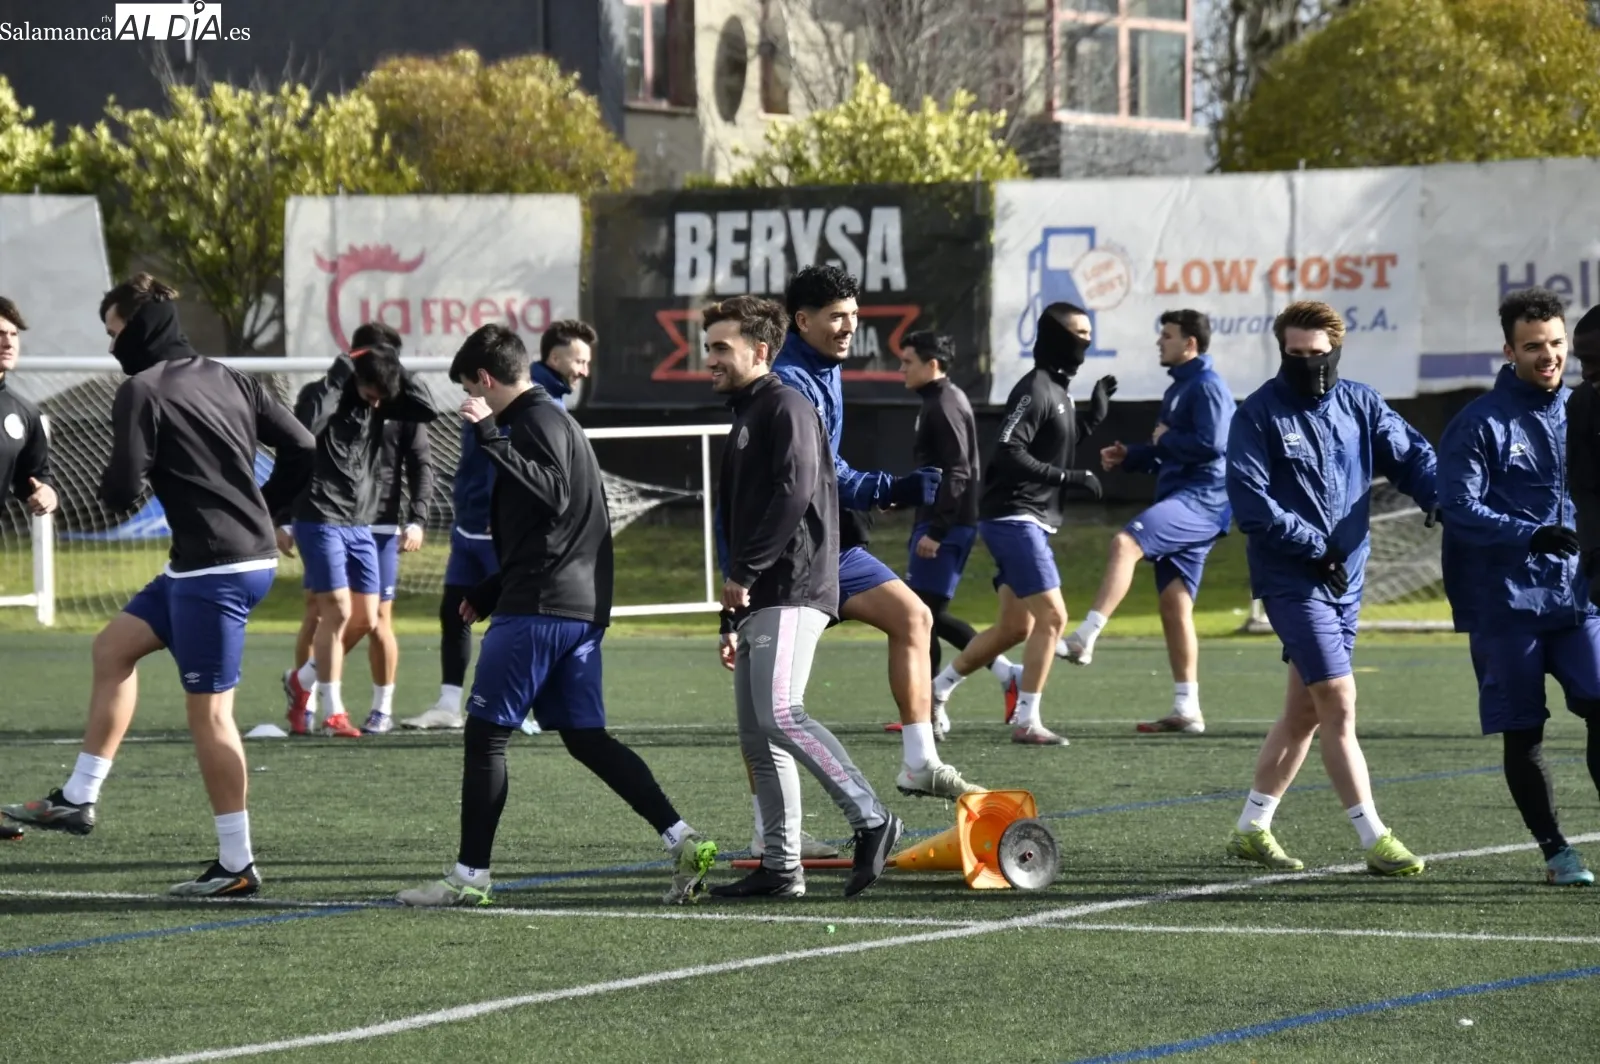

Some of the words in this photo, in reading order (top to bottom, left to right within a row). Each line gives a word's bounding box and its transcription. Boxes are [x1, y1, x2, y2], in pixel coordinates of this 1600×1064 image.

[674, 206, 907, 296] BERYSA
[1154, 259, 1256, 295] LOW
[1268, 254, 1398, 292] COST
